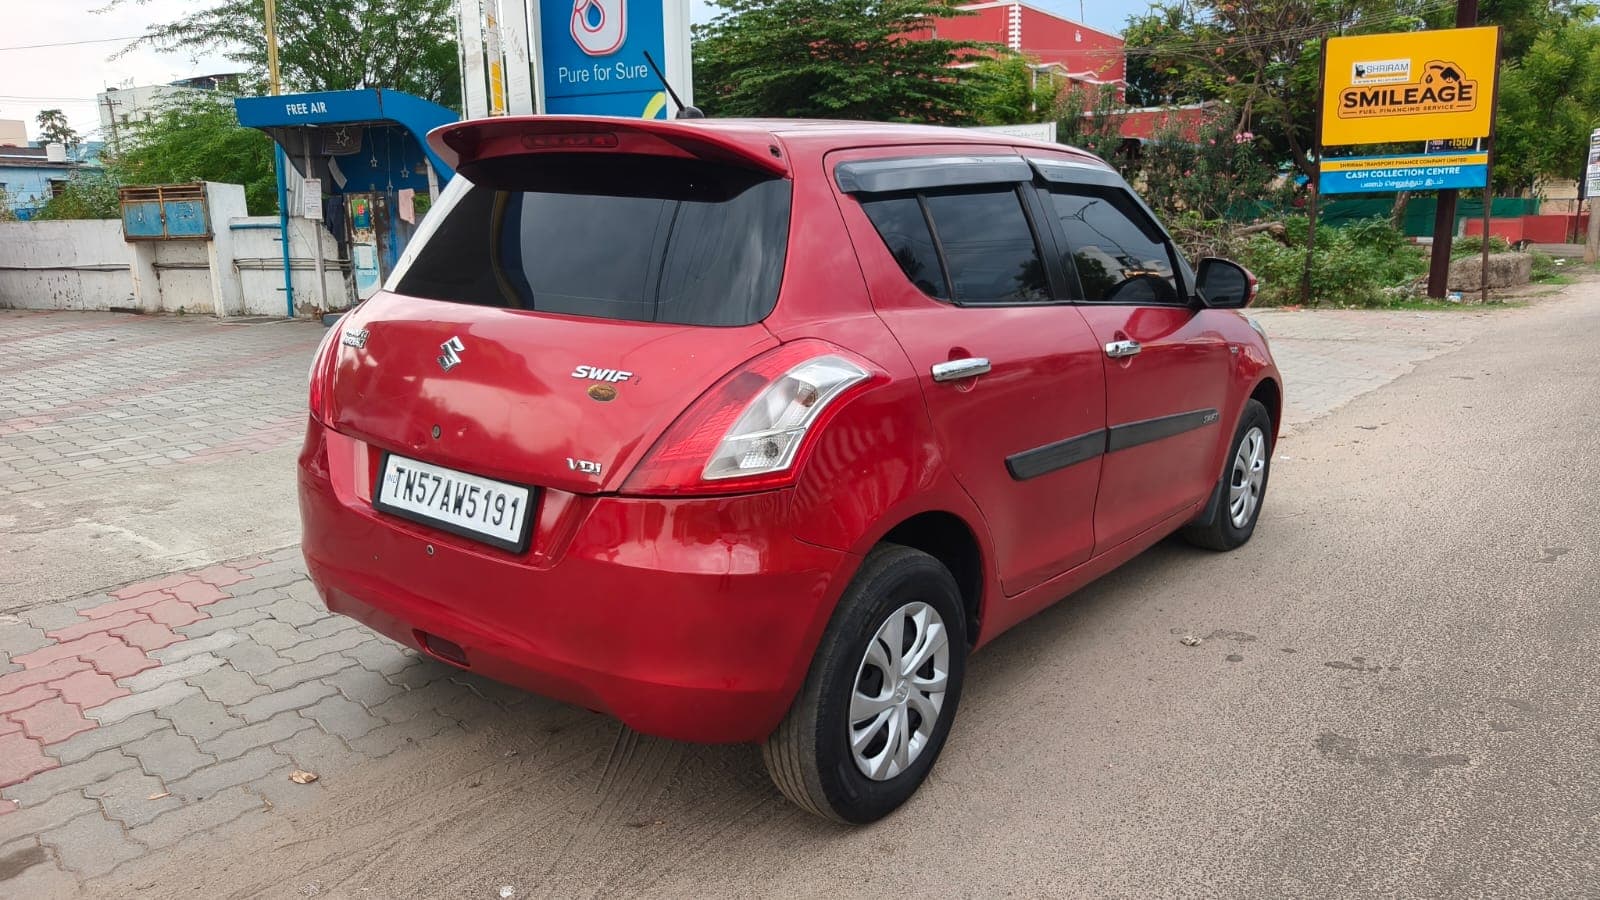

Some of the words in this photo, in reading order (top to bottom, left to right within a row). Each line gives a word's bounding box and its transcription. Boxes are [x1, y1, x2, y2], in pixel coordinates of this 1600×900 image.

[559, 67, 590, 84] Pure
[593, 64, 611, 81] for
[615, 62, 648, 80] Sure
[1366, 63, 1409, 74] SHRIRAM
[1343, 83, 1473, 108] SMILEAGE
[286, 102, 309, 115] FREE
[311, 101, 328, 114] AIR
[1364, 159, 1395, 167] TRANSPORT
[1395, 158, 1419, 166] FINANCE
[1345, 171, 1369, 179] CASH
[1370, 168, 1425, 178] COLLECTION
[1426, 166, 1461, 176] CENTRE
[394, 466, 521, 531] TN57AW5191
